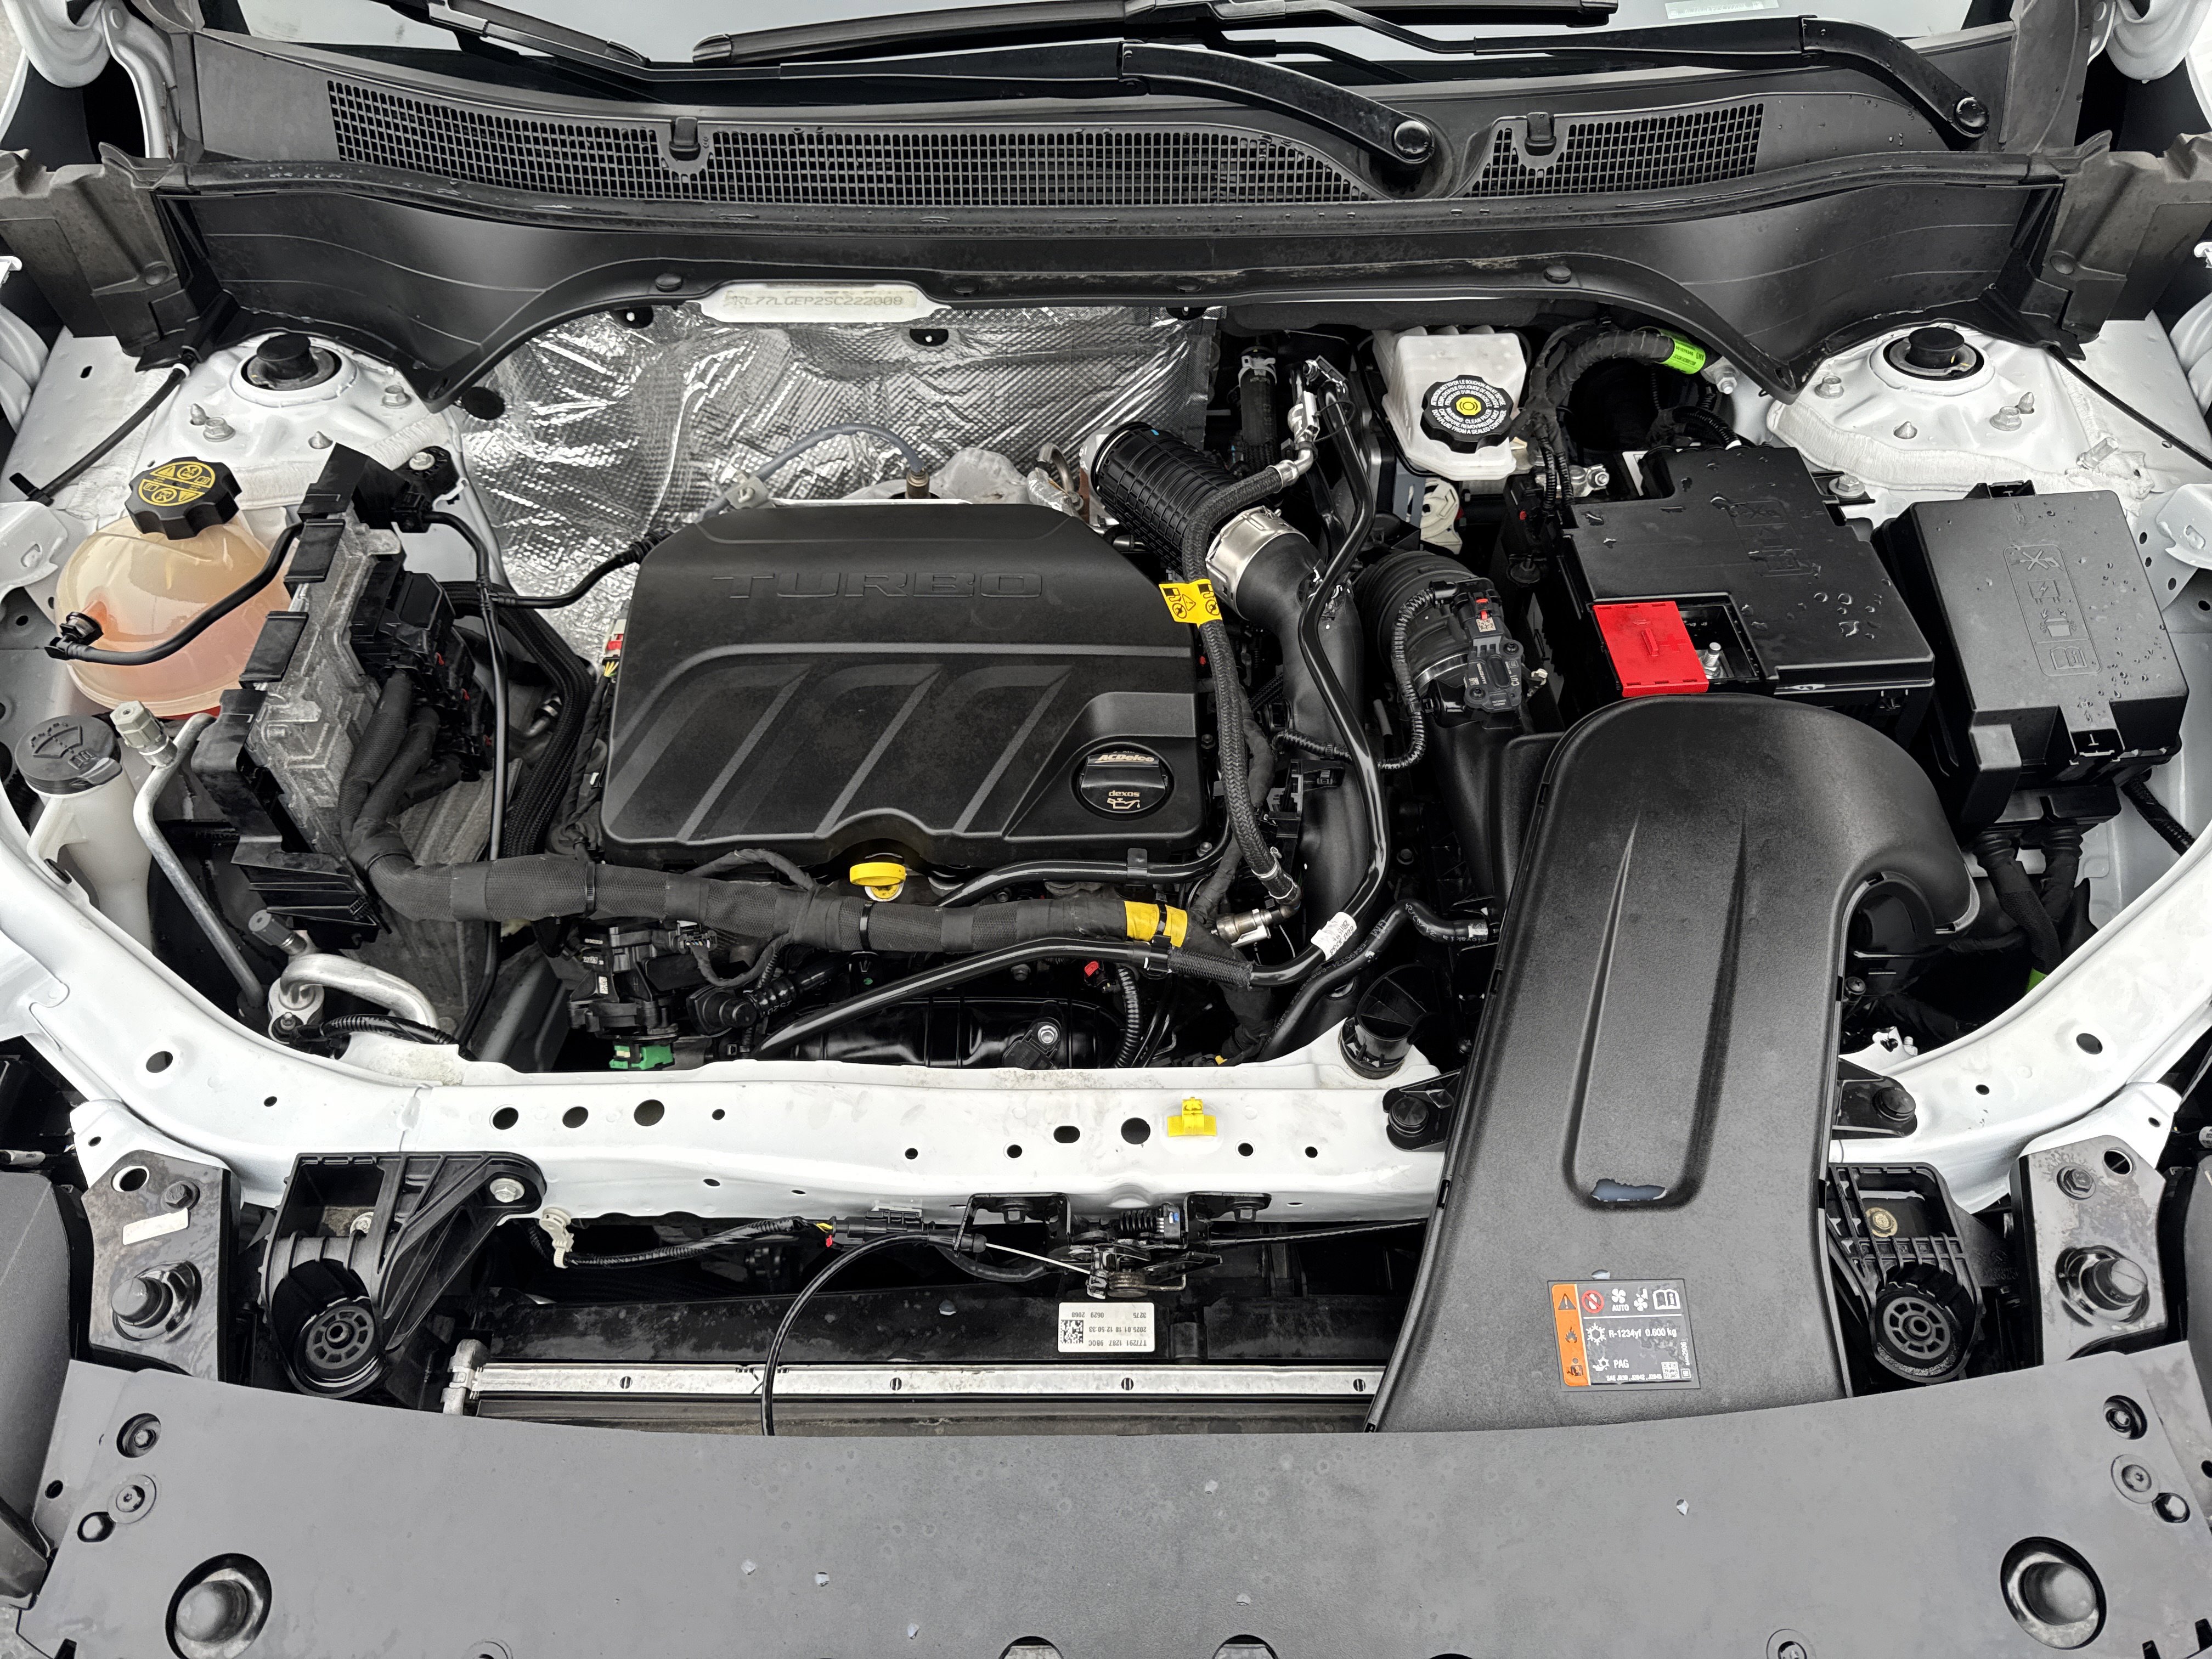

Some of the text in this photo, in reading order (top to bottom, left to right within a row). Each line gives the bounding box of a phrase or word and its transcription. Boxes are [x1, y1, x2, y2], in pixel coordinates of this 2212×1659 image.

[1438, 408, 1448, 417] CAP
[1443, 415, 1461, 427] BEFORE
[1438, 419, 1453, 430] FLUID
[1450, 425, 1467, 434] FROM
[1471, 426, 1491, 435] SEALED
[1487, 409, 1506, 430] CONTAINER
[712, 572, 1043, 599] TURBO
[1612, 1304, 1629, 1312] AUTO
[1609, 1328, 1677, 1339] R-1234yf 0.600 kg
[1613, 1359, 1629, 1368] PAG
